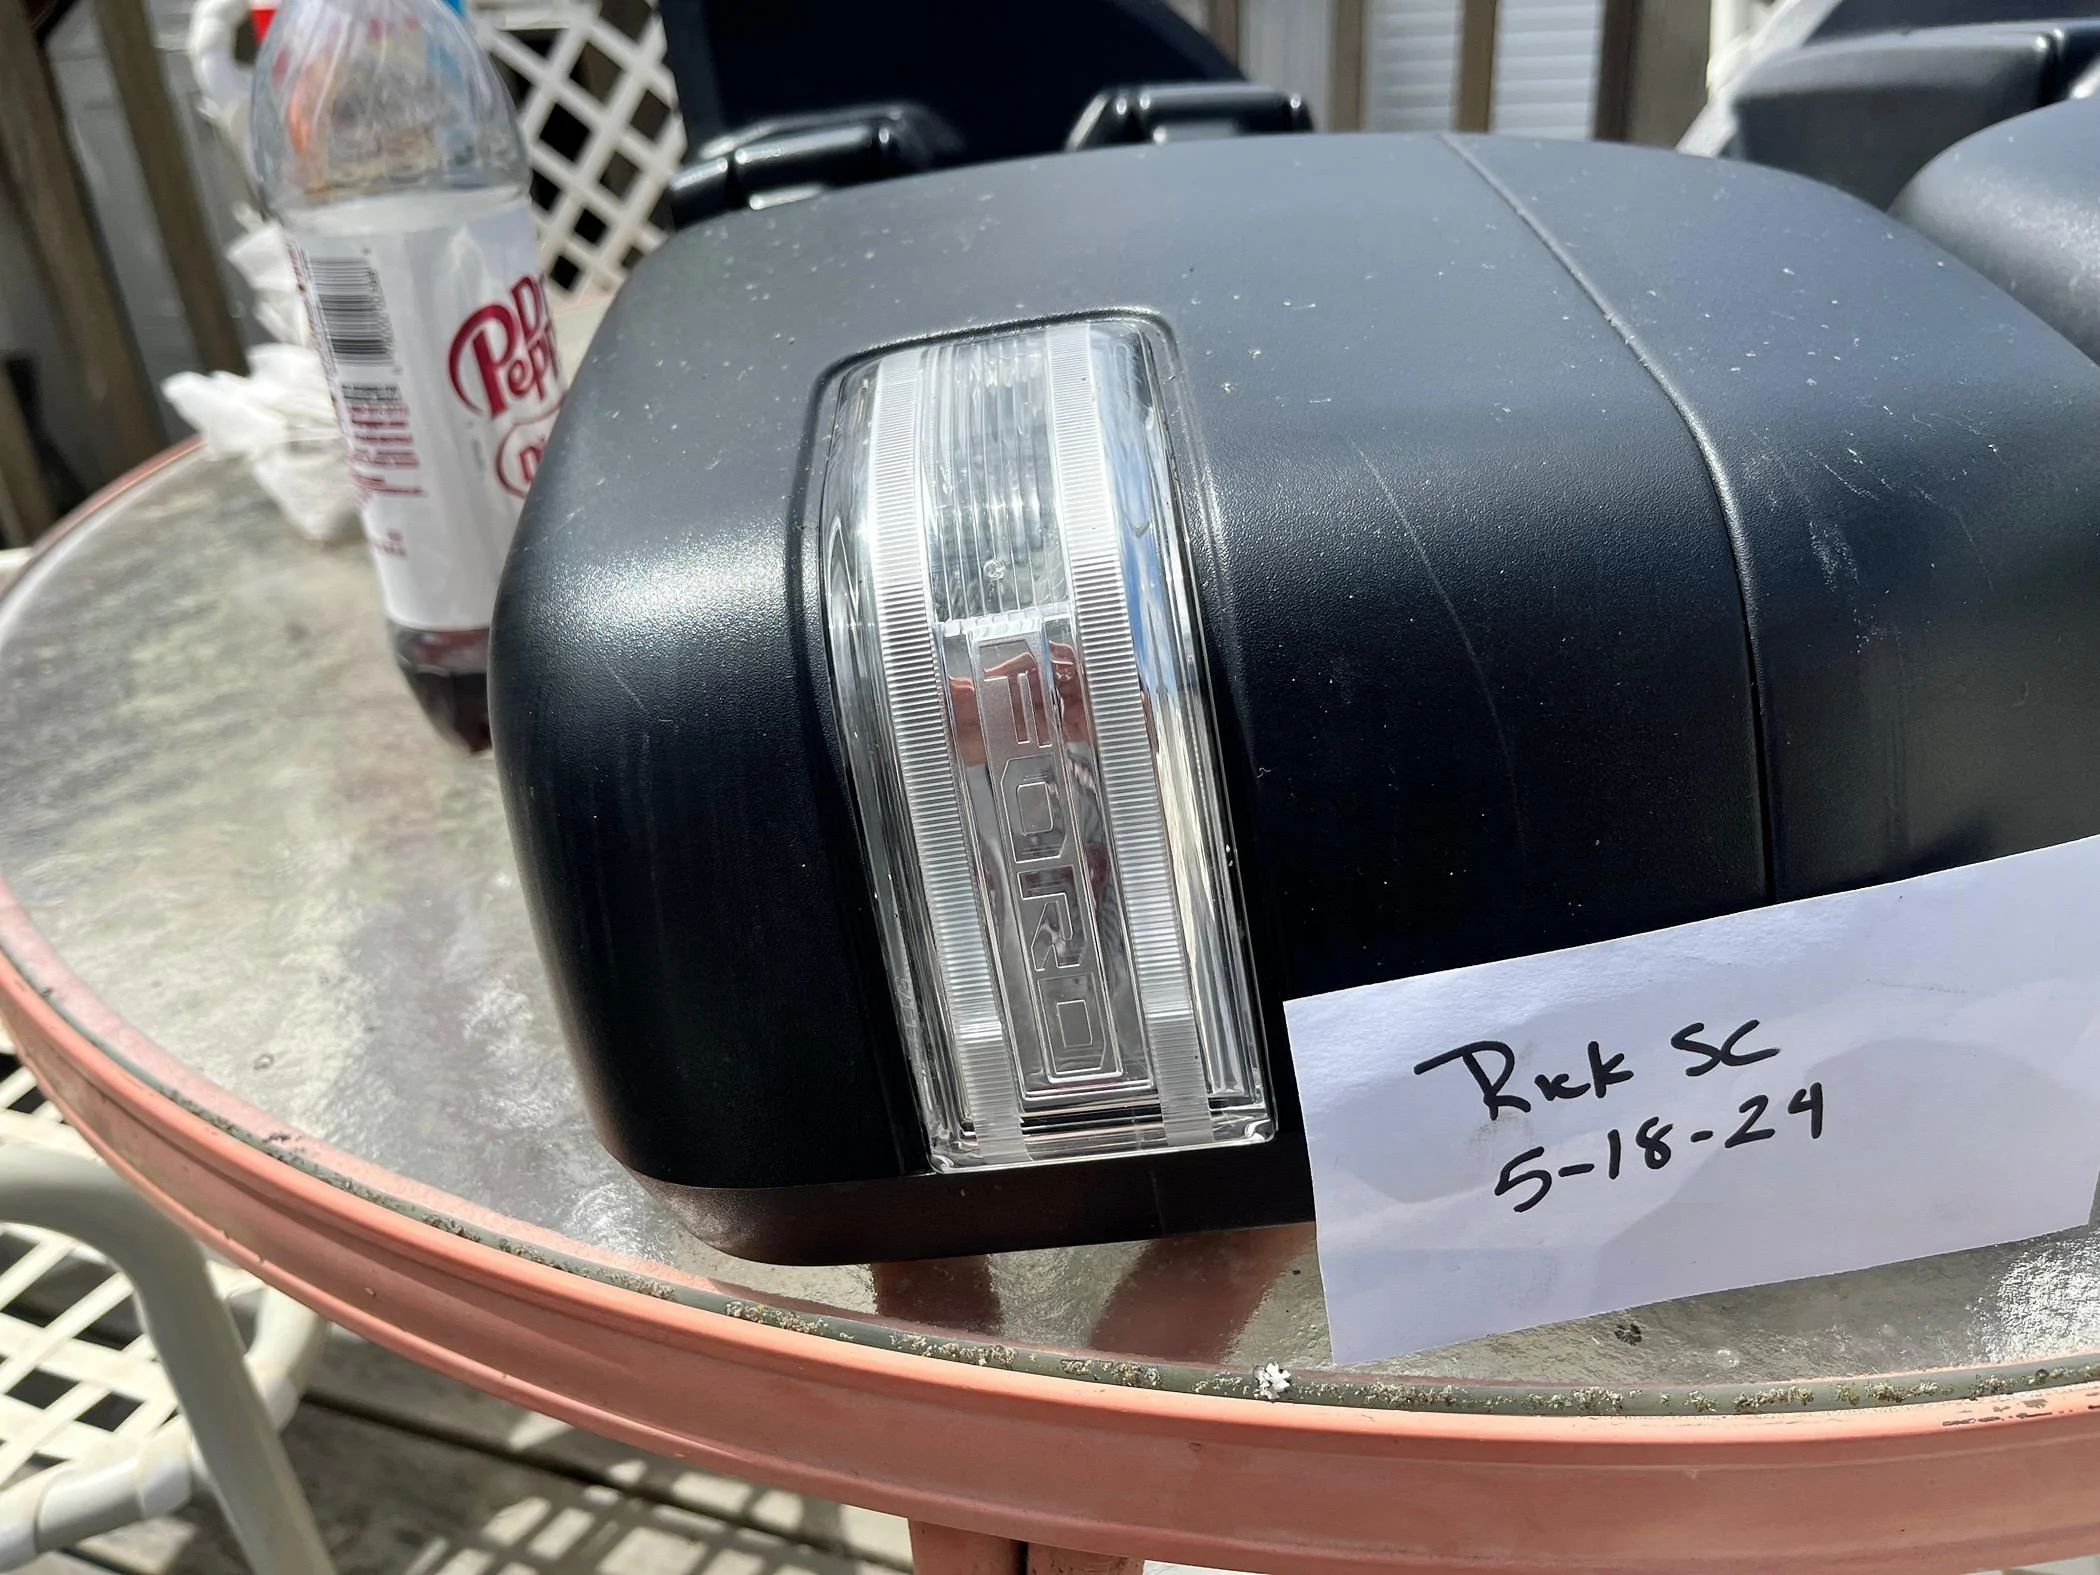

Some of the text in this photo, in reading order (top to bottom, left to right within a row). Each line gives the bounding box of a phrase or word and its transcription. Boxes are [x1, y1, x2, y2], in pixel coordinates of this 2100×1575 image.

[978, 641, 1108, 1075] FORD
[1670, 1019, 1780, 1077] SC
[1494, 1082, 1824, 1213] 5-18-24
